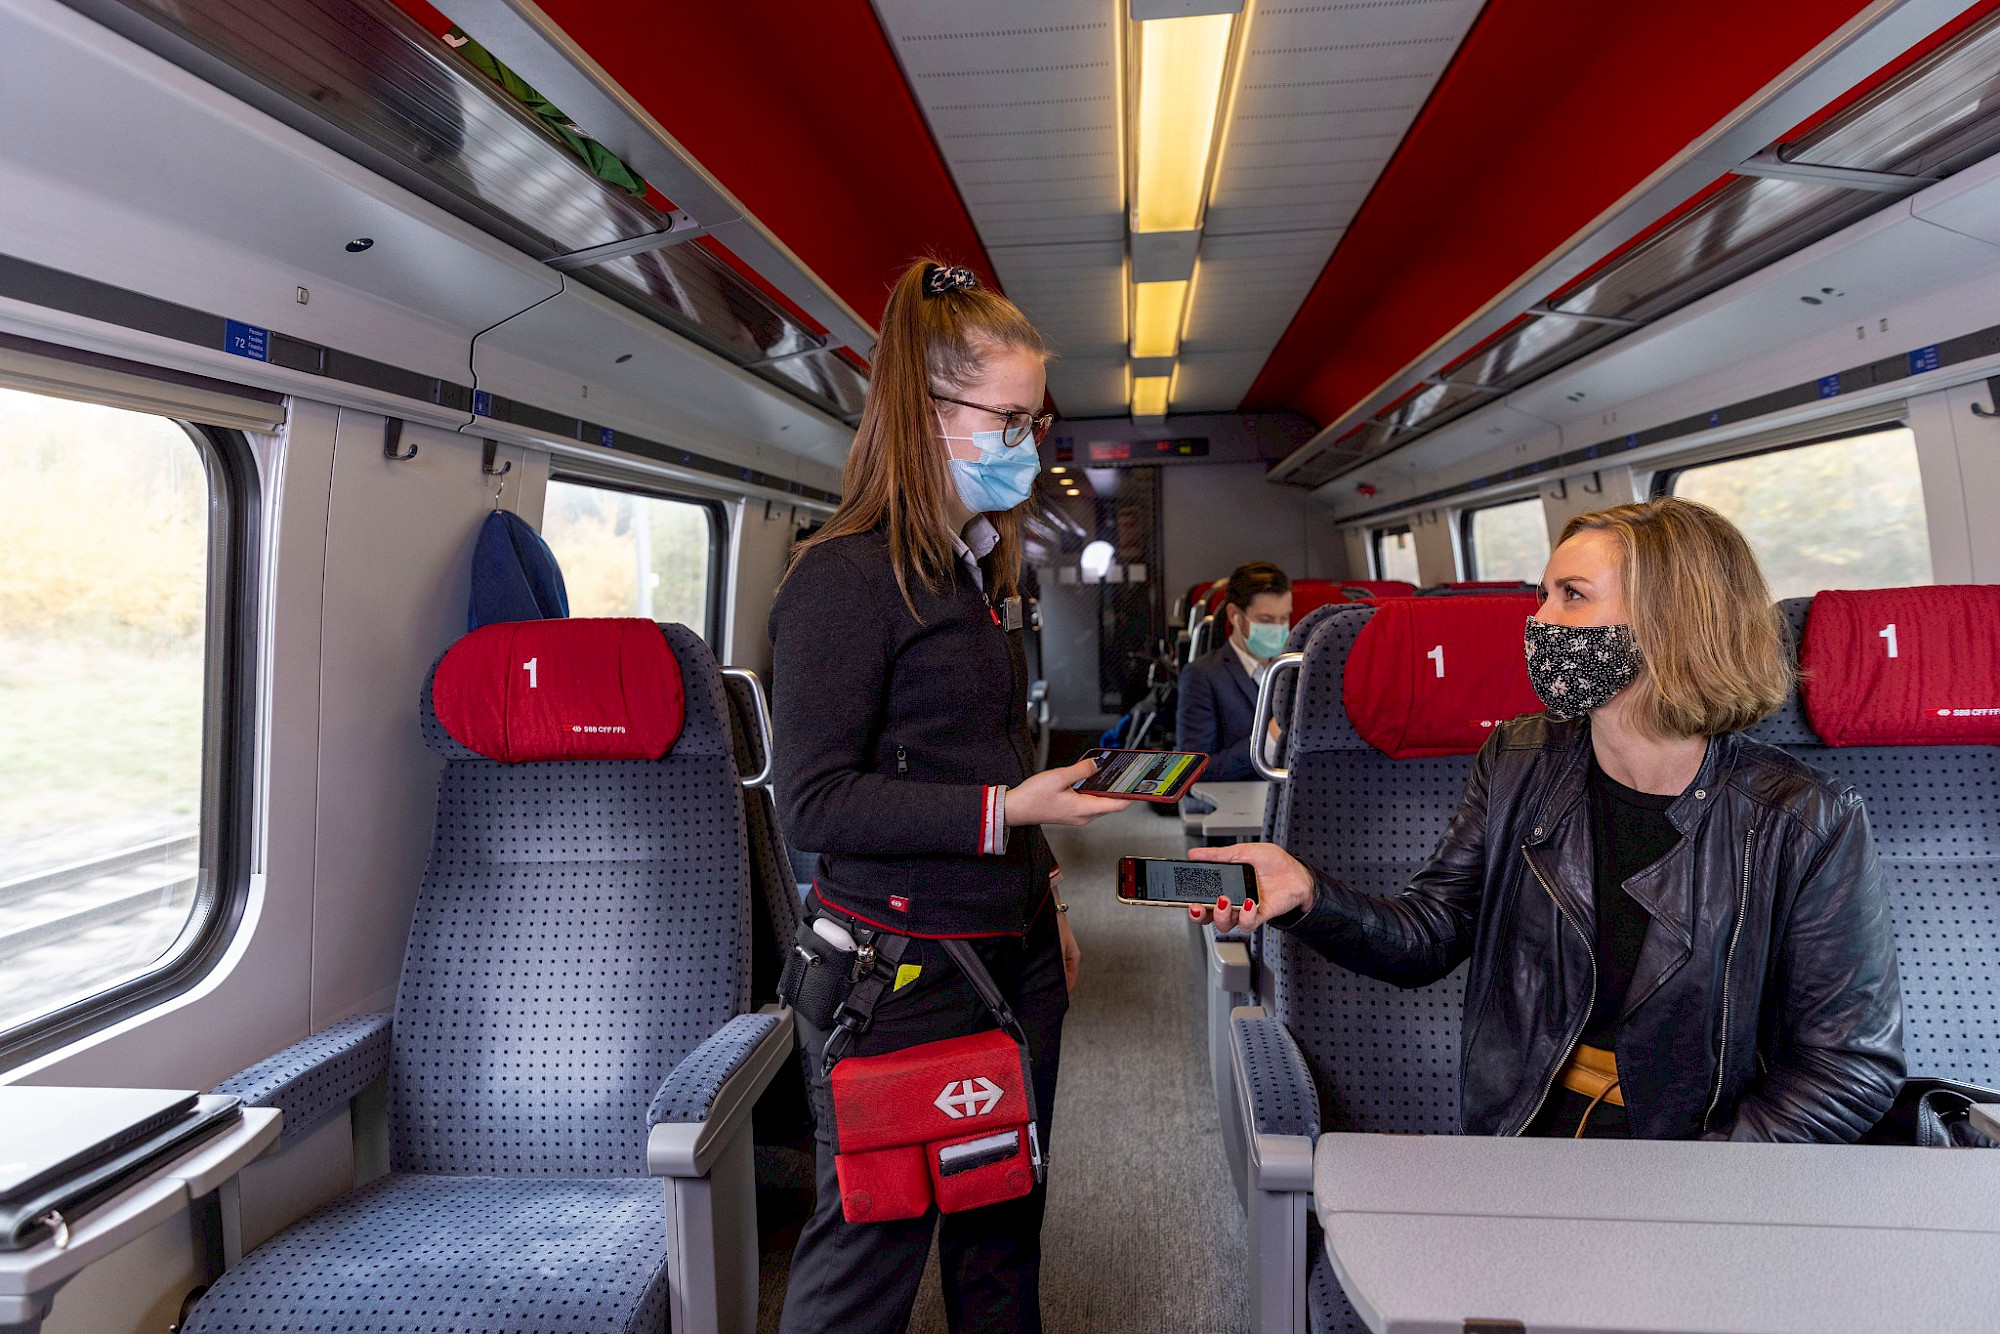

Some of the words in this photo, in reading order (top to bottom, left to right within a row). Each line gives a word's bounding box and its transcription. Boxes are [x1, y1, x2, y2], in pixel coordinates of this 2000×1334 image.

[235, 337, 246, 349] 72
[1879, 624, 1898, 658] 1
[1427, 645, 1445, 678] 1
[523, 657, 538, 688] 1
[1953, 708, 1970, 716] SBB
[1971, 708, 1987, 716] CFF
[583, 725, 597, 733] SBB
